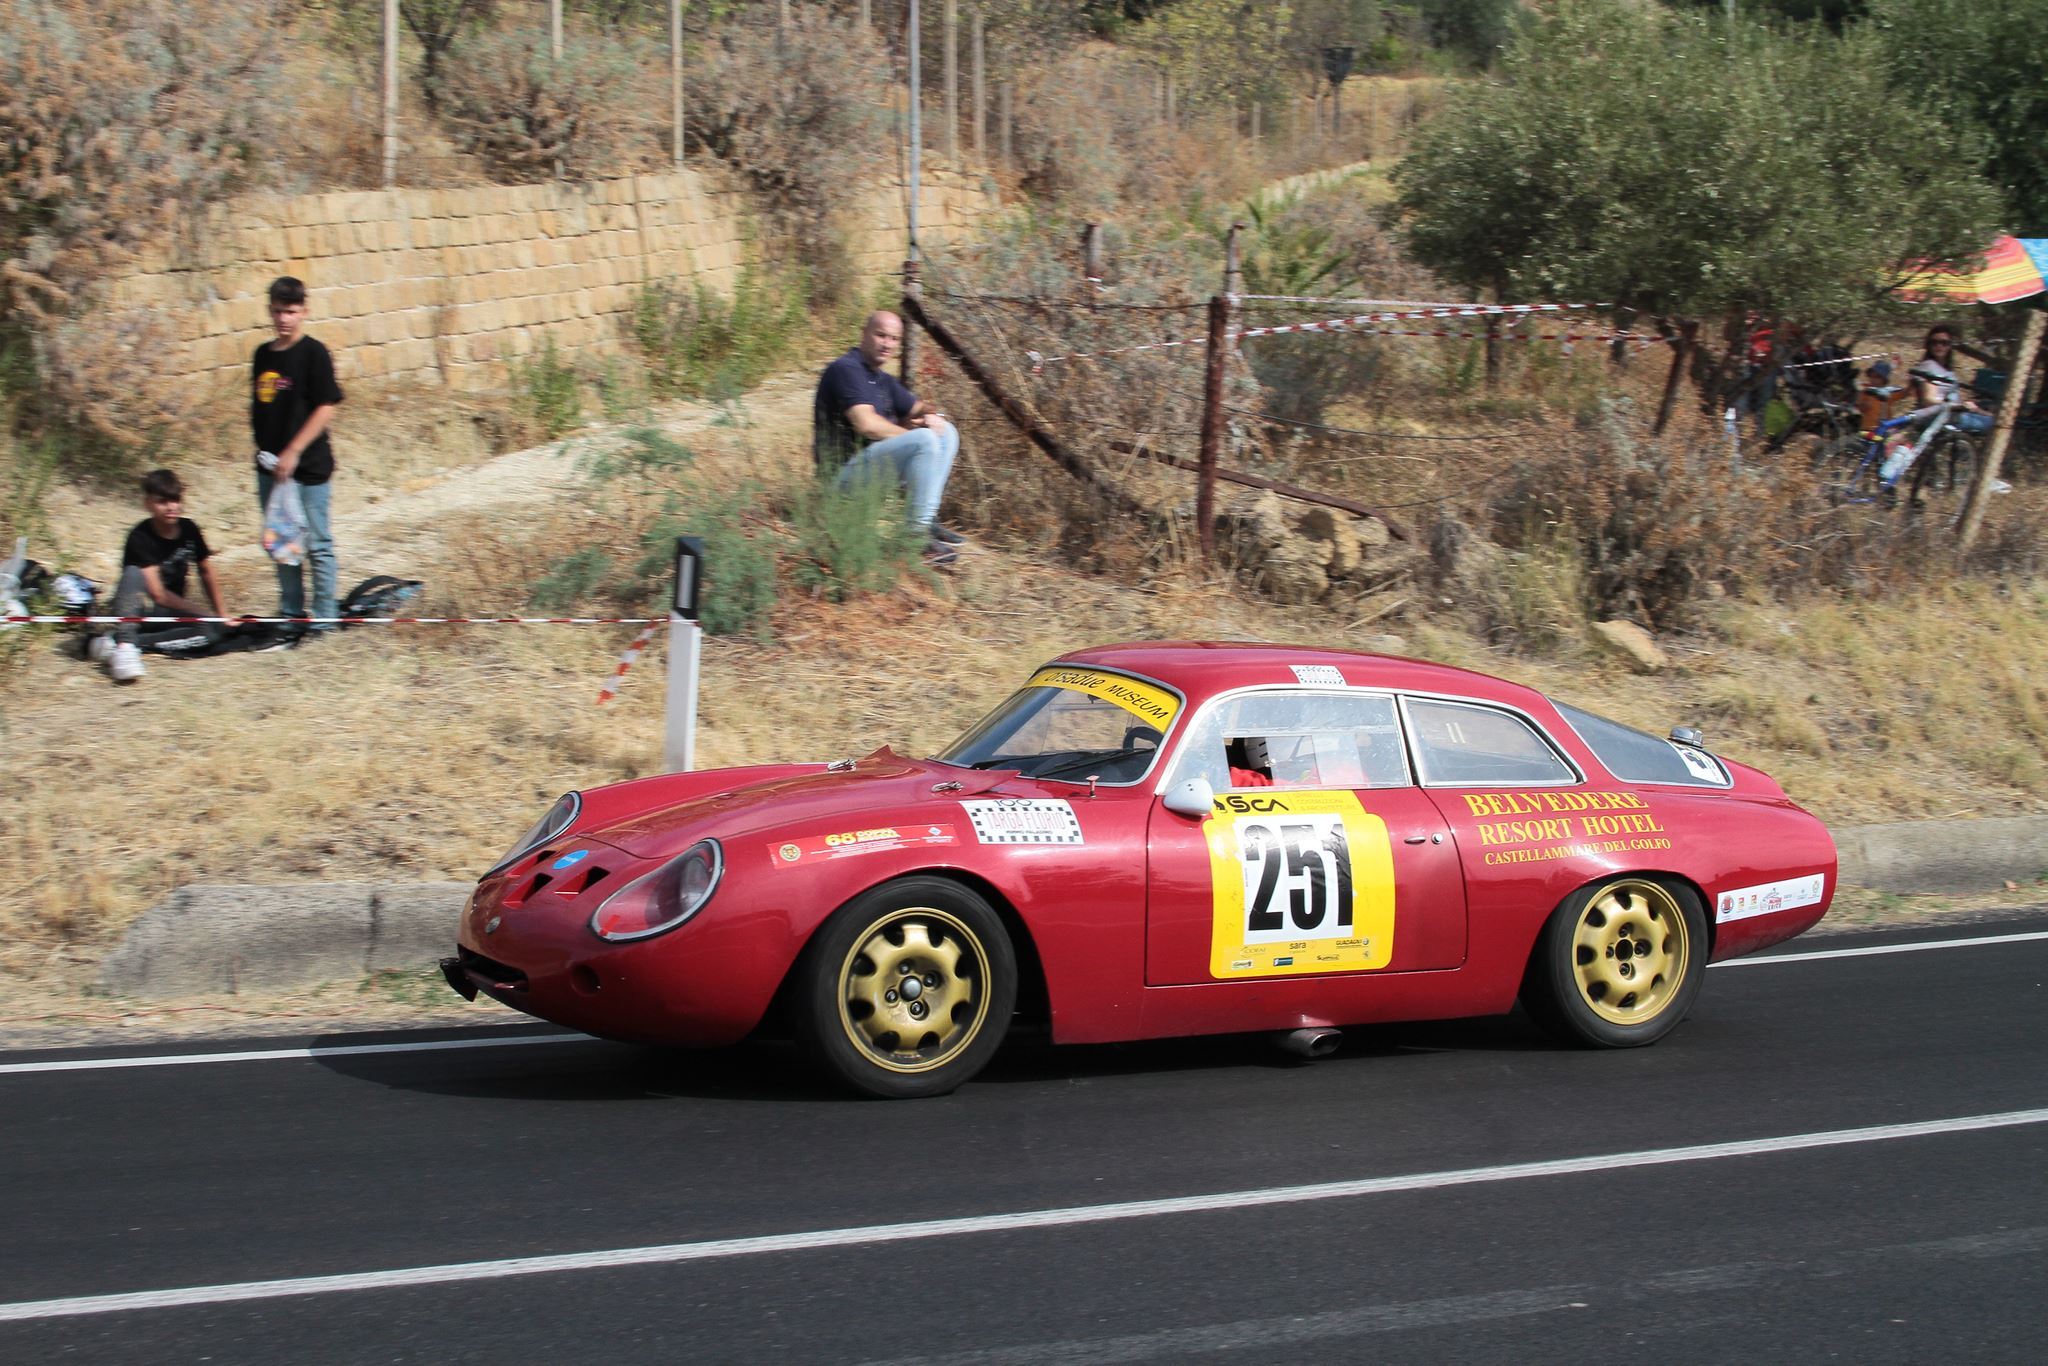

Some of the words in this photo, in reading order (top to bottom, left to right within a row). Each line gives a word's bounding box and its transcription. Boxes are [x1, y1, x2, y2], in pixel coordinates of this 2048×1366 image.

[1105, 684, 1169, 719] MUSEUM
[1461, 791, 1650, 817] BELVEDERE
[984, 812, 1024, 830] TARGA
[1023, 812, 1067, 830] FLORIO
[1477, 817, 1575, 846] RESORT
[1580, 813, 1665, 837] HOTEL
[1484, 842, 1603, 866] CASTELLAMMARE
[1603, 839, 1630, 853] DEL
[1631, 838, 1672, 850] GOLFO
[1243, 823, 1354, 932] 251
[1289, 941, 1307, 950] sara
